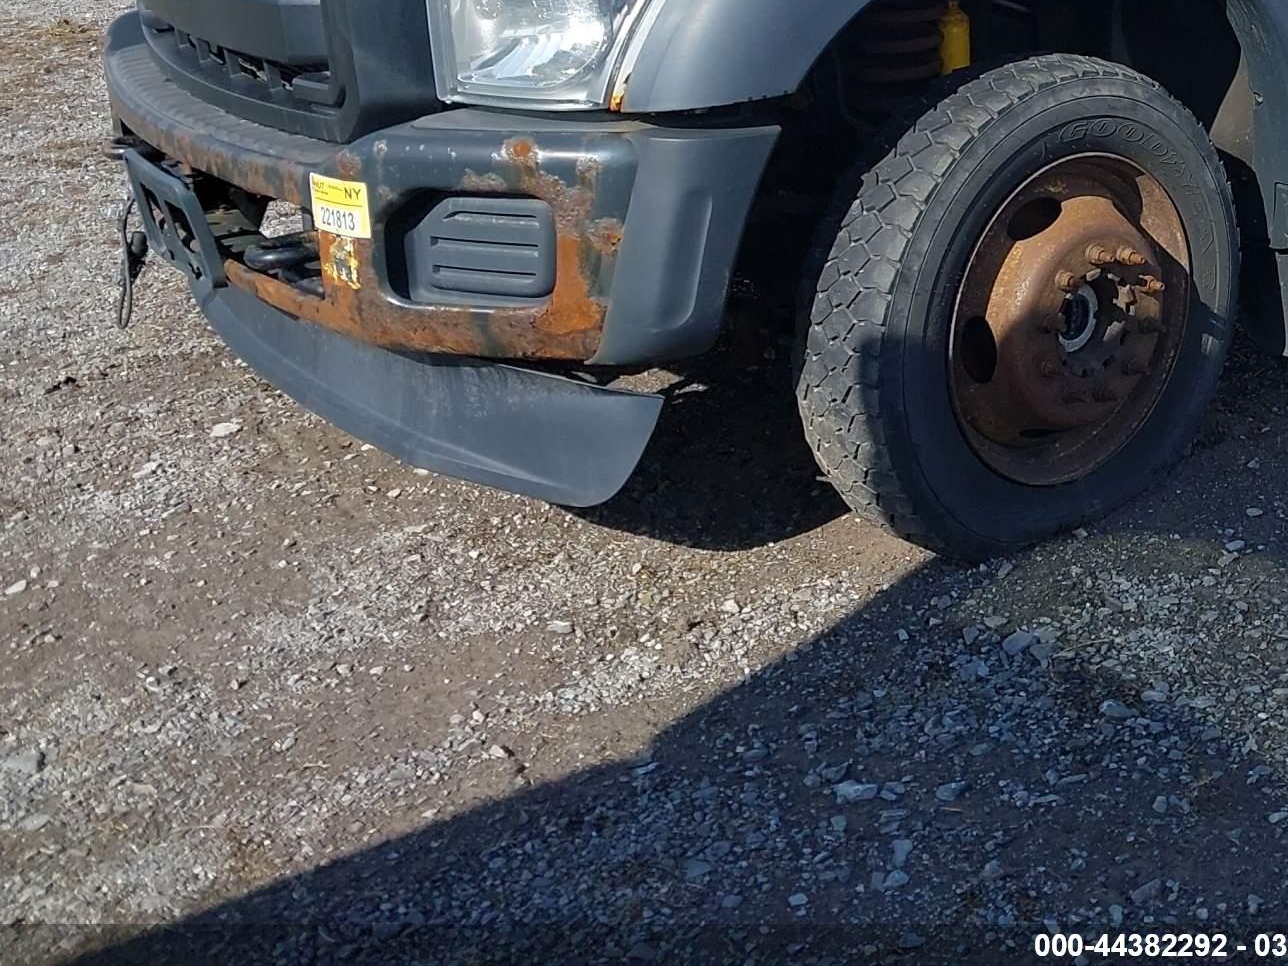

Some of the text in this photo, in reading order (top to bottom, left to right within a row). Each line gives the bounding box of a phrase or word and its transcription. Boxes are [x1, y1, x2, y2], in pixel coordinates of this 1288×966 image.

[344, 187, 361, 201] NY
[1058, 118, 1219, 291] GOODYEAR
[320, 206, 355, 231] 221813
